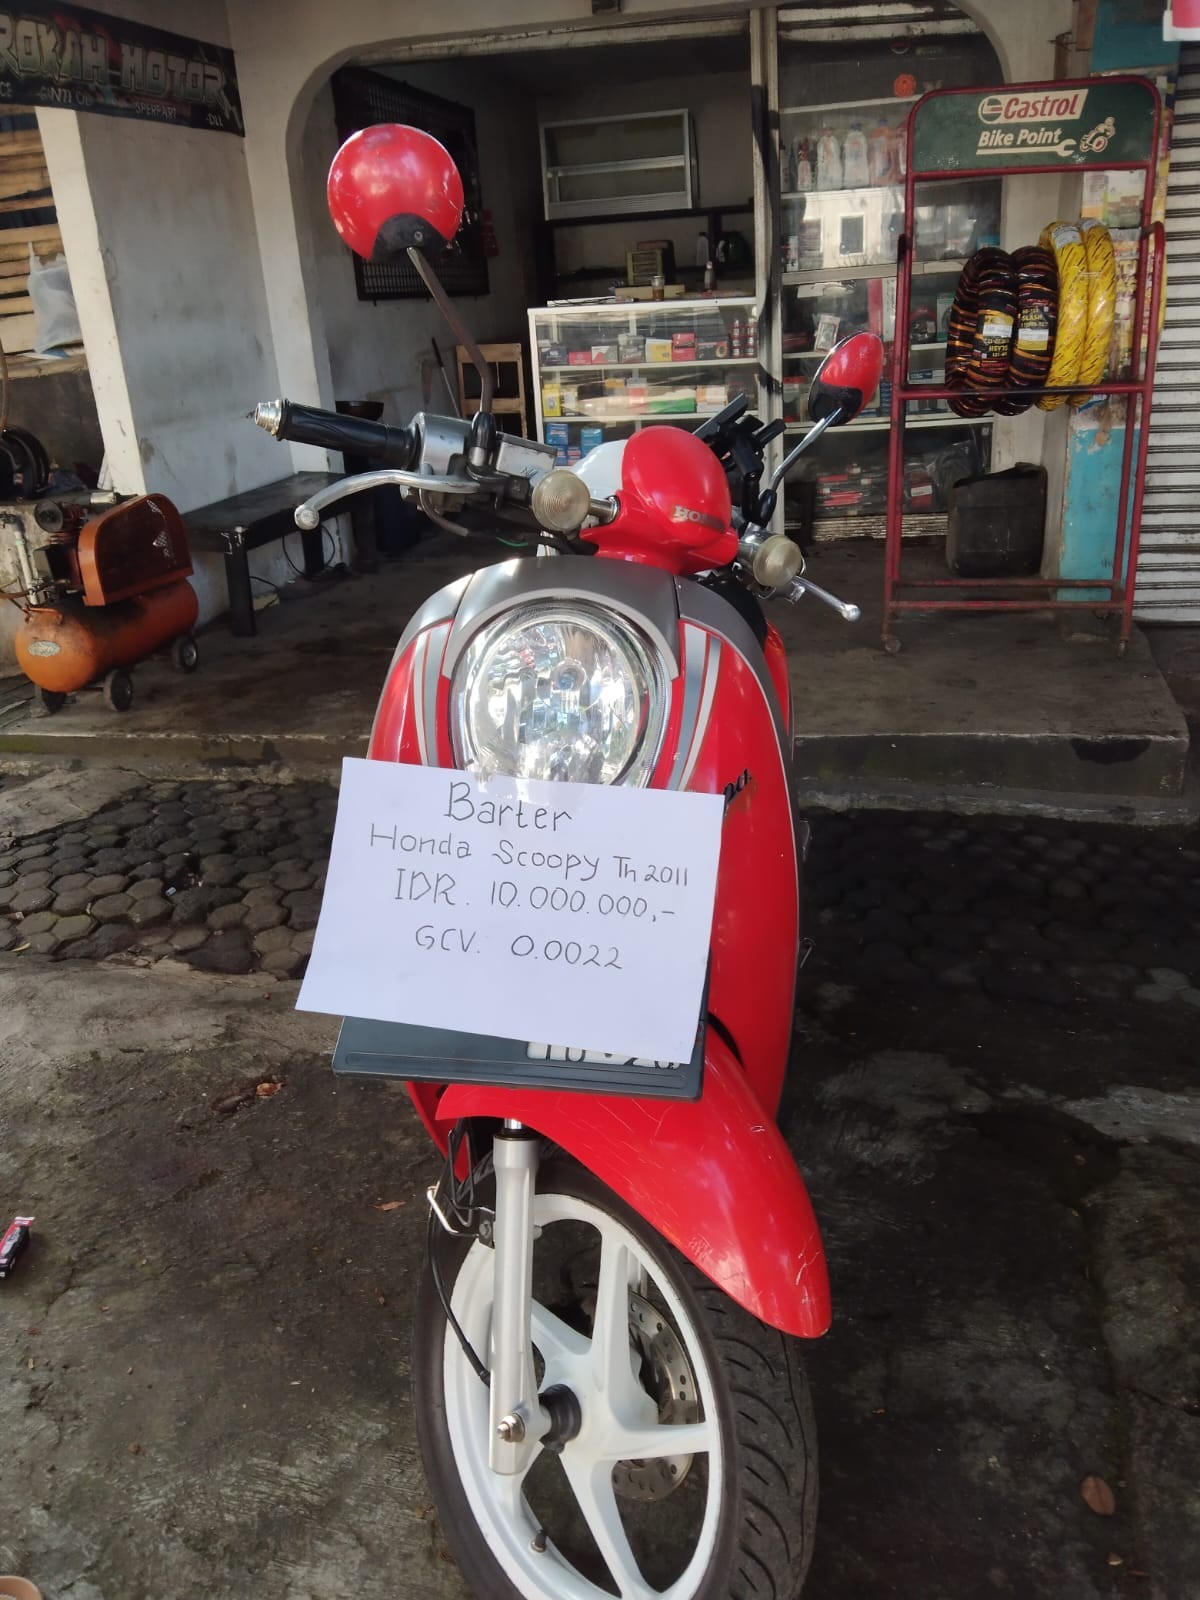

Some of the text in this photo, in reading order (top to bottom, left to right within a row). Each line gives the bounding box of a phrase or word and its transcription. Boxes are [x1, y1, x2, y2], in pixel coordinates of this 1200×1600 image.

[120, 43, 229, 108] MOTOR
[1004, 94, 1079, 119] Castrol
[978, 128, 1063, 148] Bike Point
[444, 781, 574, 832] Barter
[369, 823, 689, 887] Honda Scoopy Th 2011
[490, 881, 676, 923] 10.000.000,-
[415, 925, 623, 970] GCV. 0.0022
